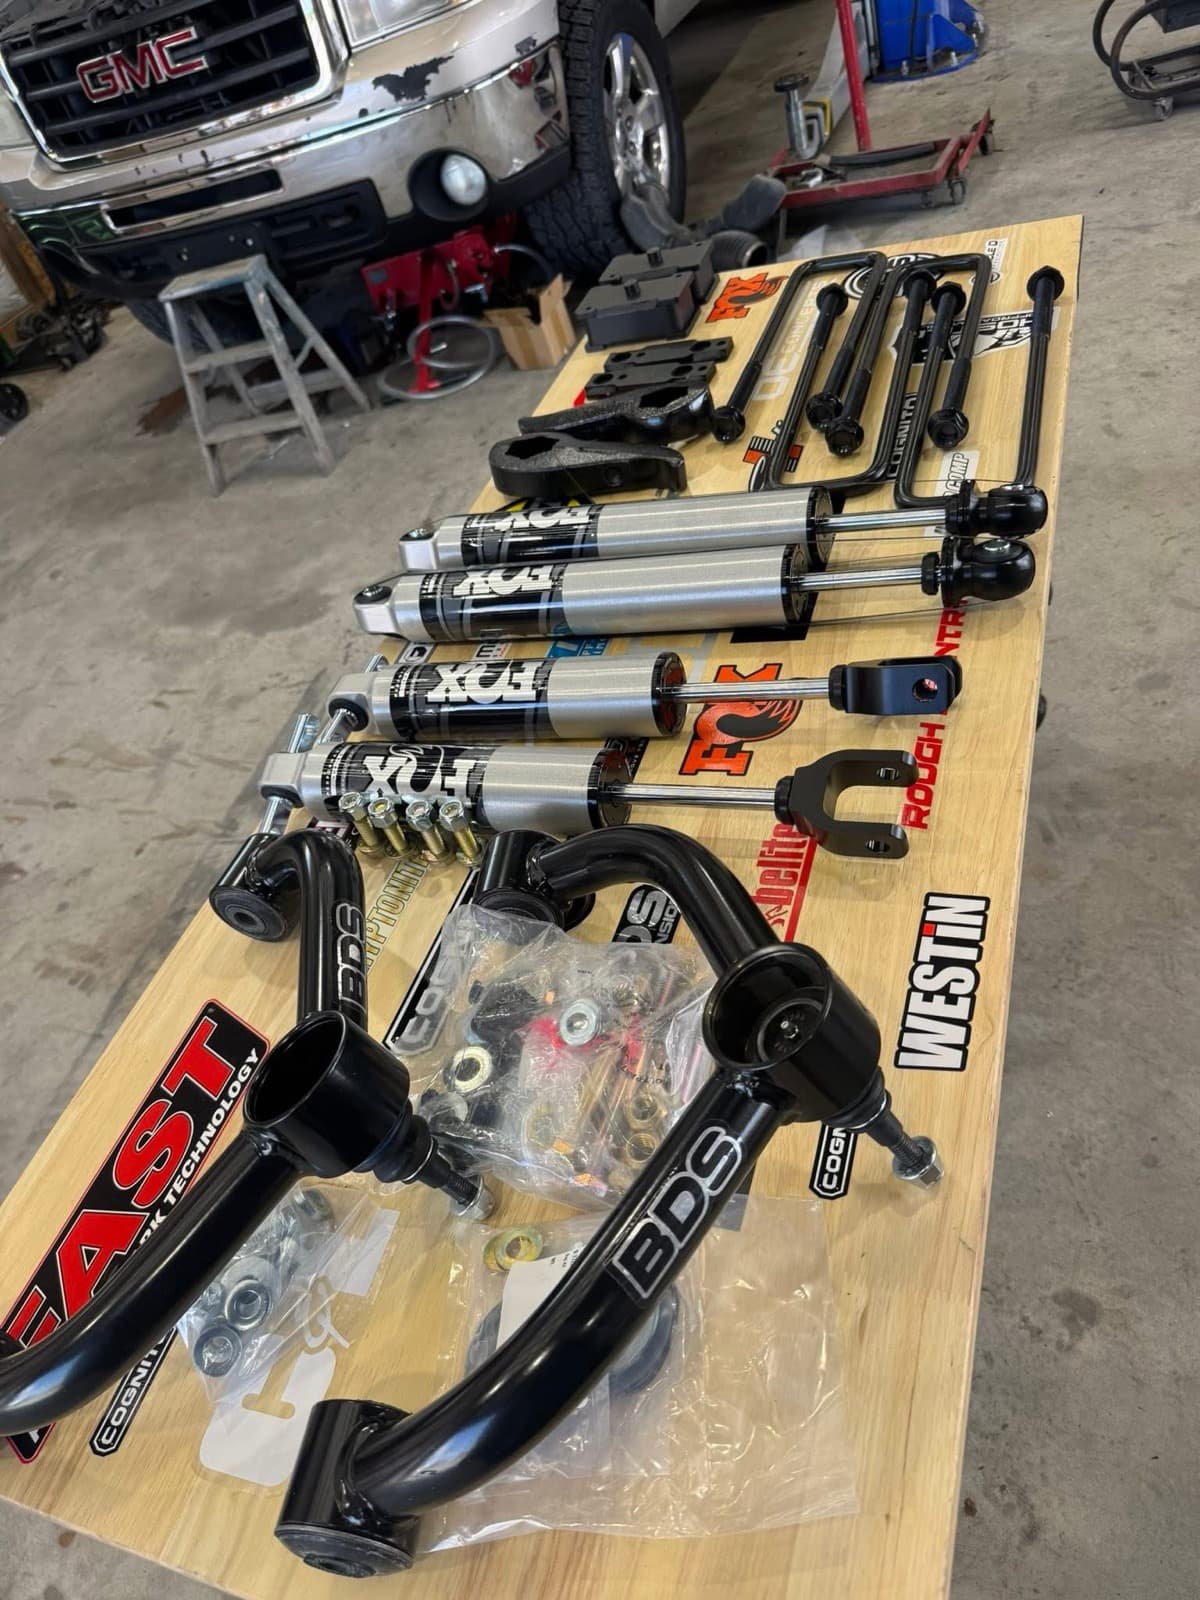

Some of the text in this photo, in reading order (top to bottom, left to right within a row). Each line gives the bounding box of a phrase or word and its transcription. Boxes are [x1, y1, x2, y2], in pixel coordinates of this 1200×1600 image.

[76, 27, 208, 103] GMC
[425, 661, 542, 704] FOX
[362, 747, 477, 804] FOX
[902, 722, 946, 829] ROUGH
[336, 903, 366, 1000] BDS
[163, 1048, 259, 1206] TECHNOLOGY
[822, 1126, 849, 1190] COGN
[613, 1126, 742, 1299] BDS
